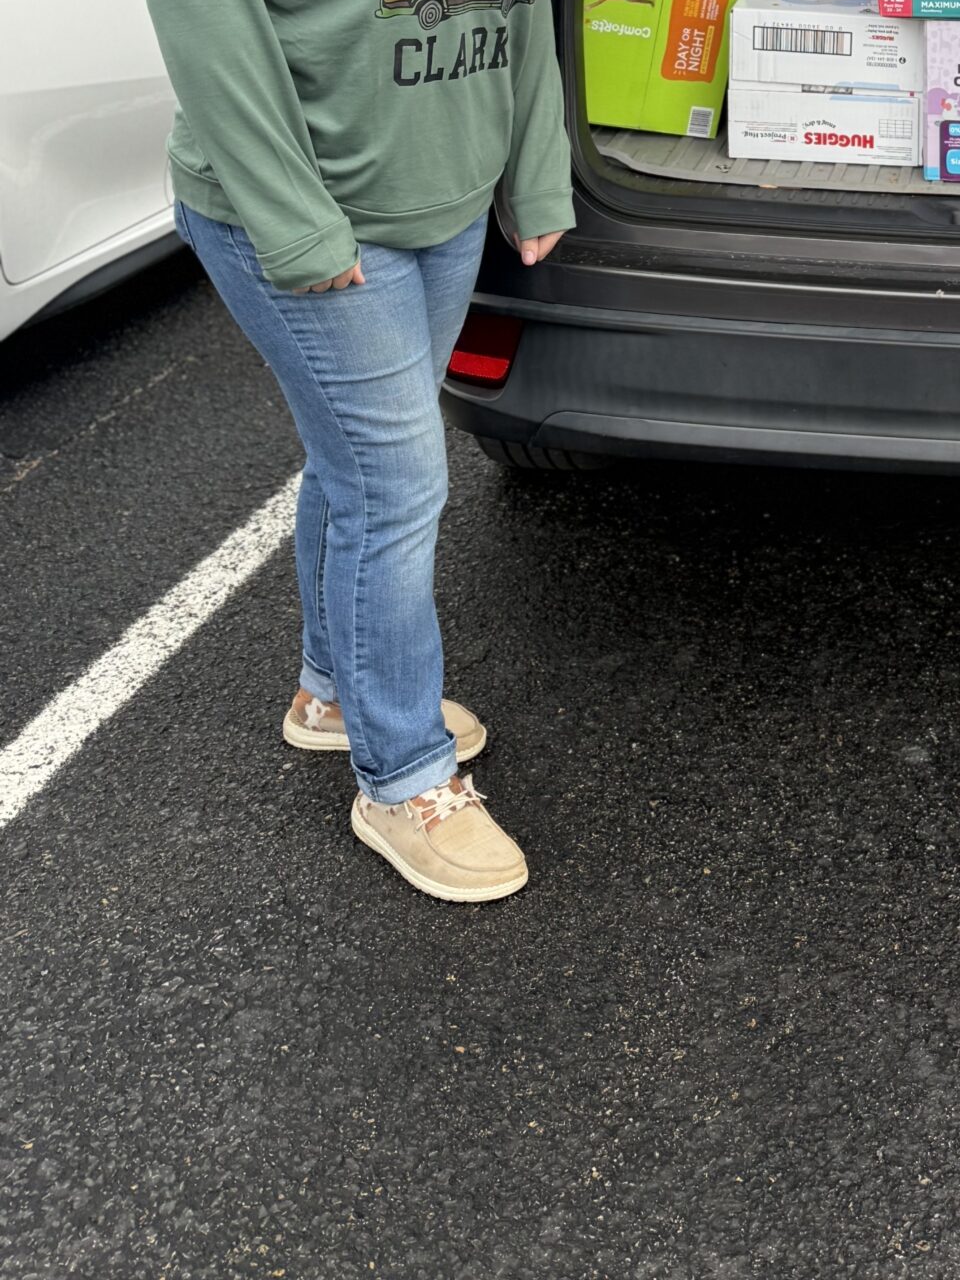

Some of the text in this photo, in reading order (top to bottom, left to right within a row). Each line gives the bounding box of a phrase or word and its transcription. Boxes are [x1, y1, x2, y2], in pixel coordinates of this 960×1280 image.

[393, 26, 508, 87] CLARK
[674, 27, 691, 70] DAY OR
[688, 29, 706, 71] NIGHT
[804, 131, 874, 149] HUGGIES
